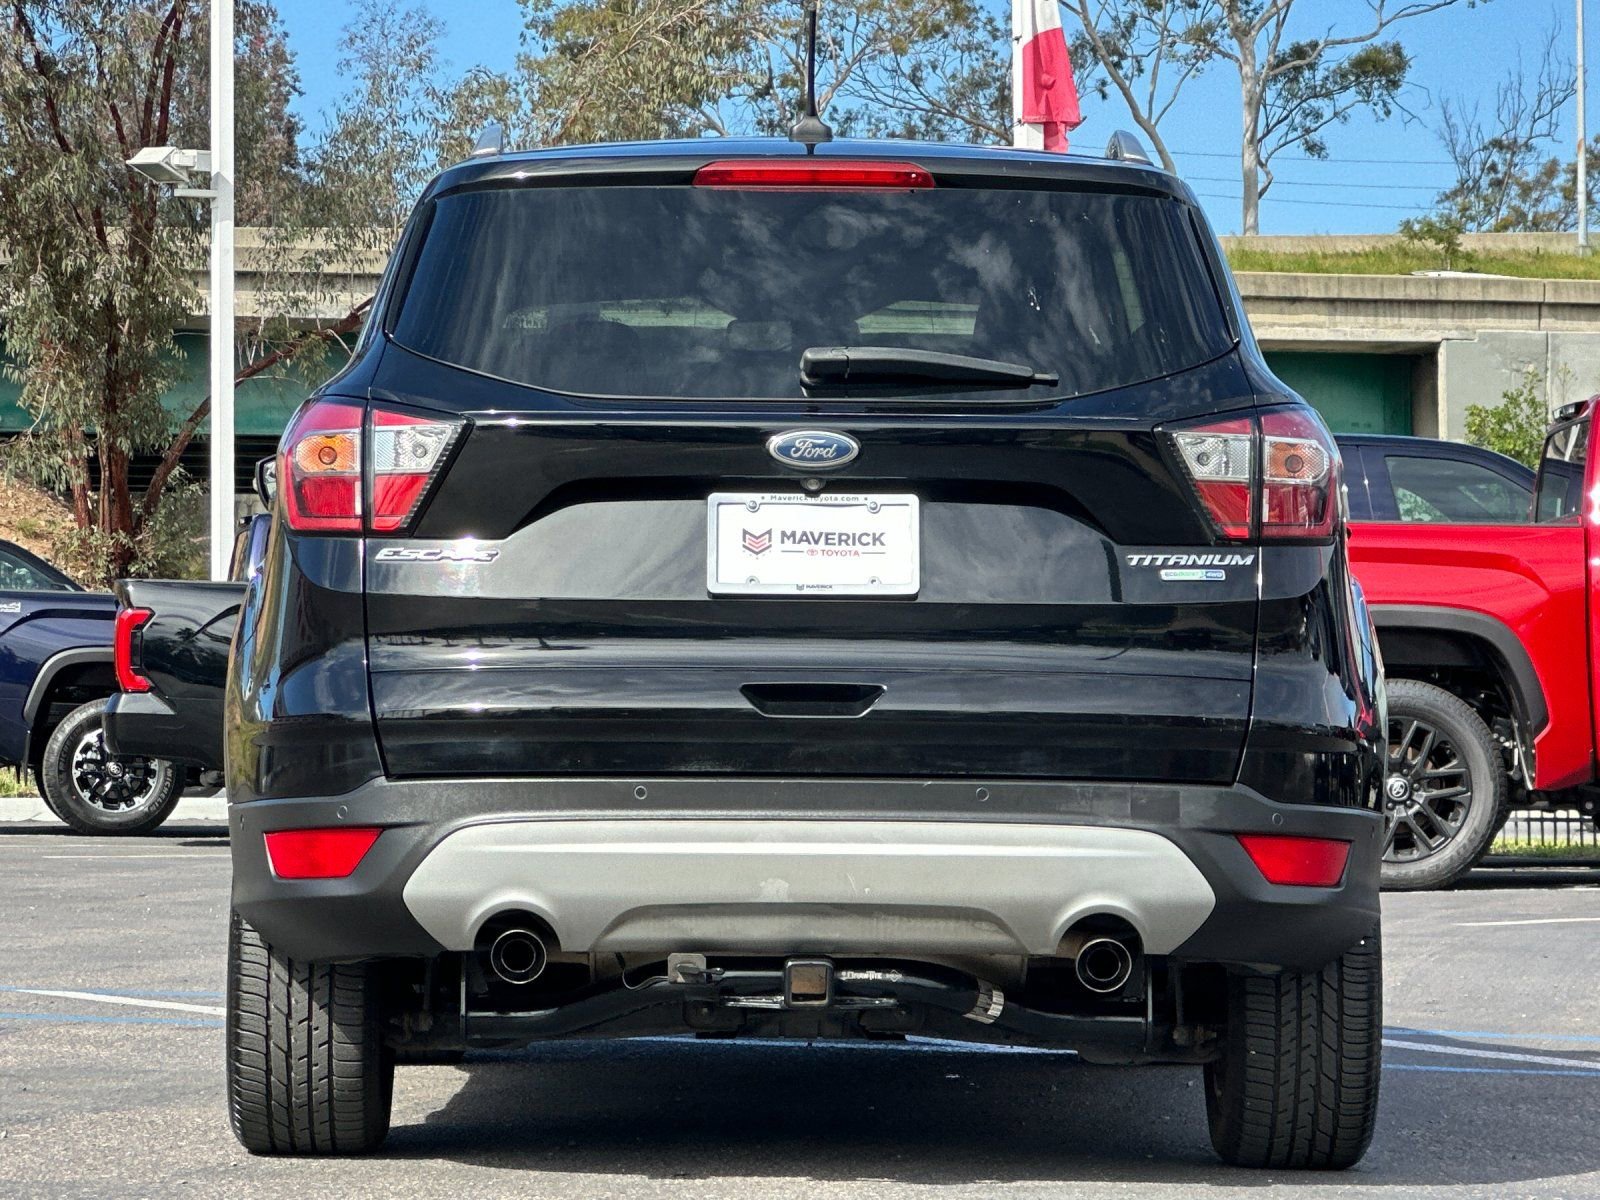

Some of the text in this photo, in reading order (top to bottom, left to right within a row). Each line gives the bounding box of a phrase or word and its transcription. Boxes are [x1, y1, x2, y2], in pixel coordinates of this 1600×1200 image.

[790, 438, 838, 458] Ford
[781, 530, 886, 547] MAVERICK
[375, 547, 499, 561] ESCAE
[820, 549, 860, 557] TOYOTA
[1127, 554, 1255, 566] TITANIUM
[149, 768, 173, 812] MICHELIN
